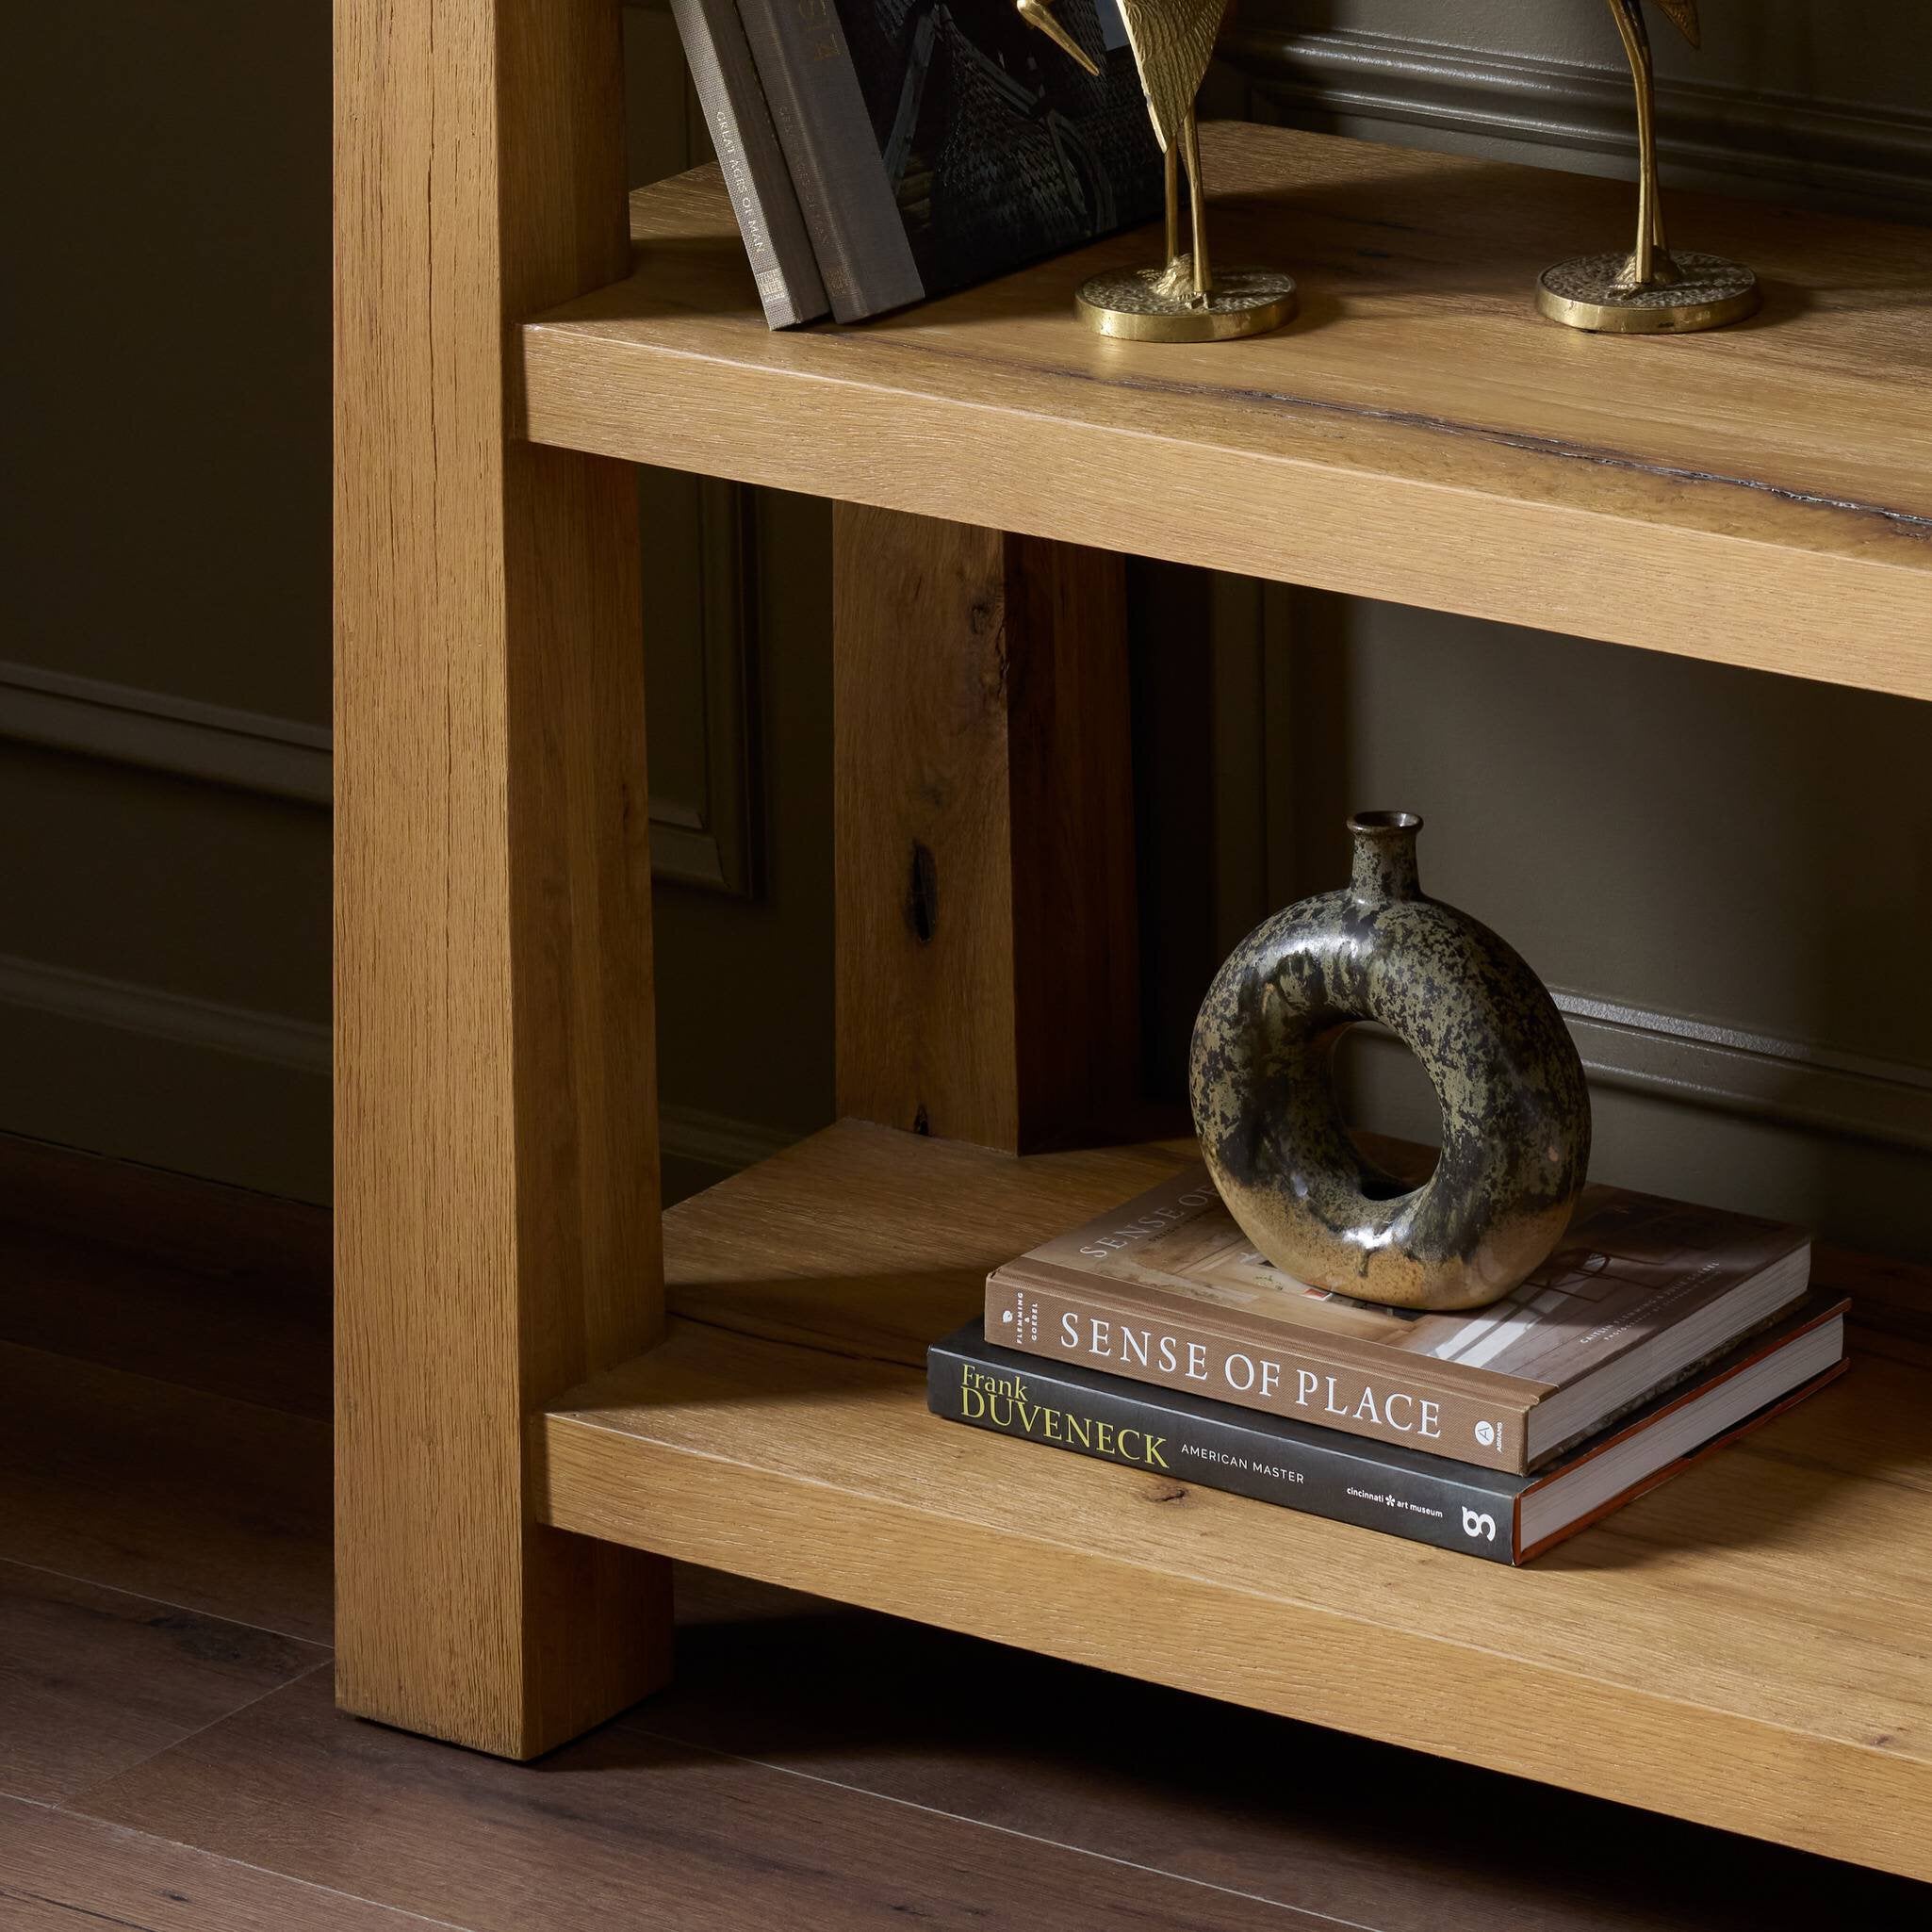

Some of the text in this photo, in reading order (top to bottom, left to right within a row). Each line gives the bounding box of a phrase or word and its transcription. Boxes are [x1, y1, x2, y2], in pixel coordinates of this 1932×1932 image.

[1079, 1206, 1185, 1258] SENSE
[1016, 1292, 1024, 1345] FLEMMING
[961, 1364, 1028, 1402] Frank
[1060, 1312, 1442, 1438] SENSE OF PLACE
[960, 1385, 1170, 1468] DUVENECK
[1181, 1443, 1305, 1484] AMERICAN MASTER
[1346, 1486, 1444, 1519] cincinnati art museum
